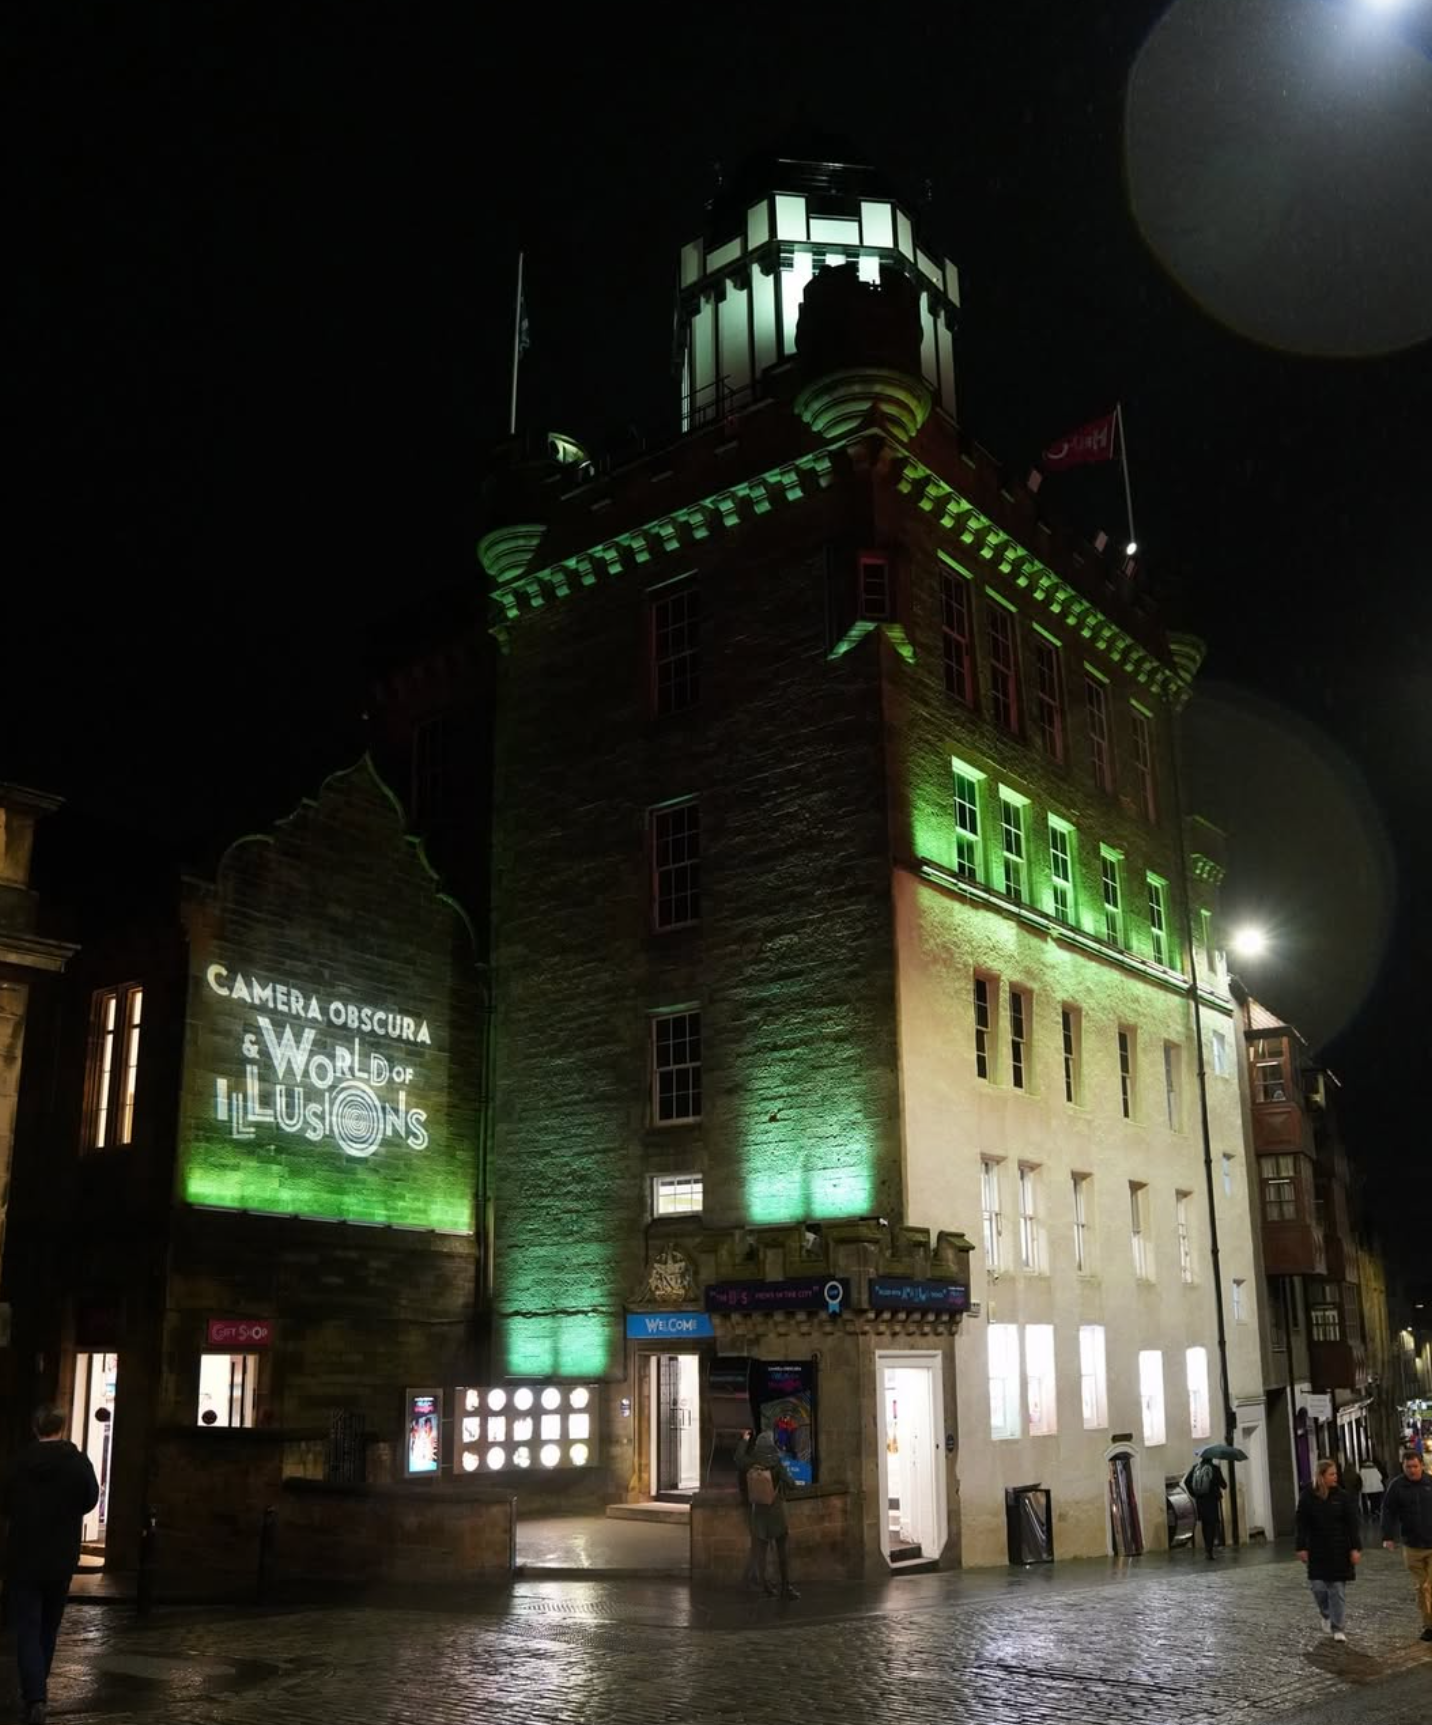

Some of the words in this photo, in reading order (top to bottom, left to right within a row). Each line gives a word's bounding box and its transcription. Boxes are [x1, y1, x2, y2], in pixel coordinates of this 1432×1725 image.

[207, 964, 323, 1021] CAMERA
[329, 1001, 431, 1044] OBSCURA
[241, 1033, 261, 1060] &
[256, 1015, 391, 1089] WORLD
[391, 1065, 415, 1085] OF
[216, 1064, 429, 1157] ILLUSIONS
[644, 1317, 699, 1334] WELCOME
